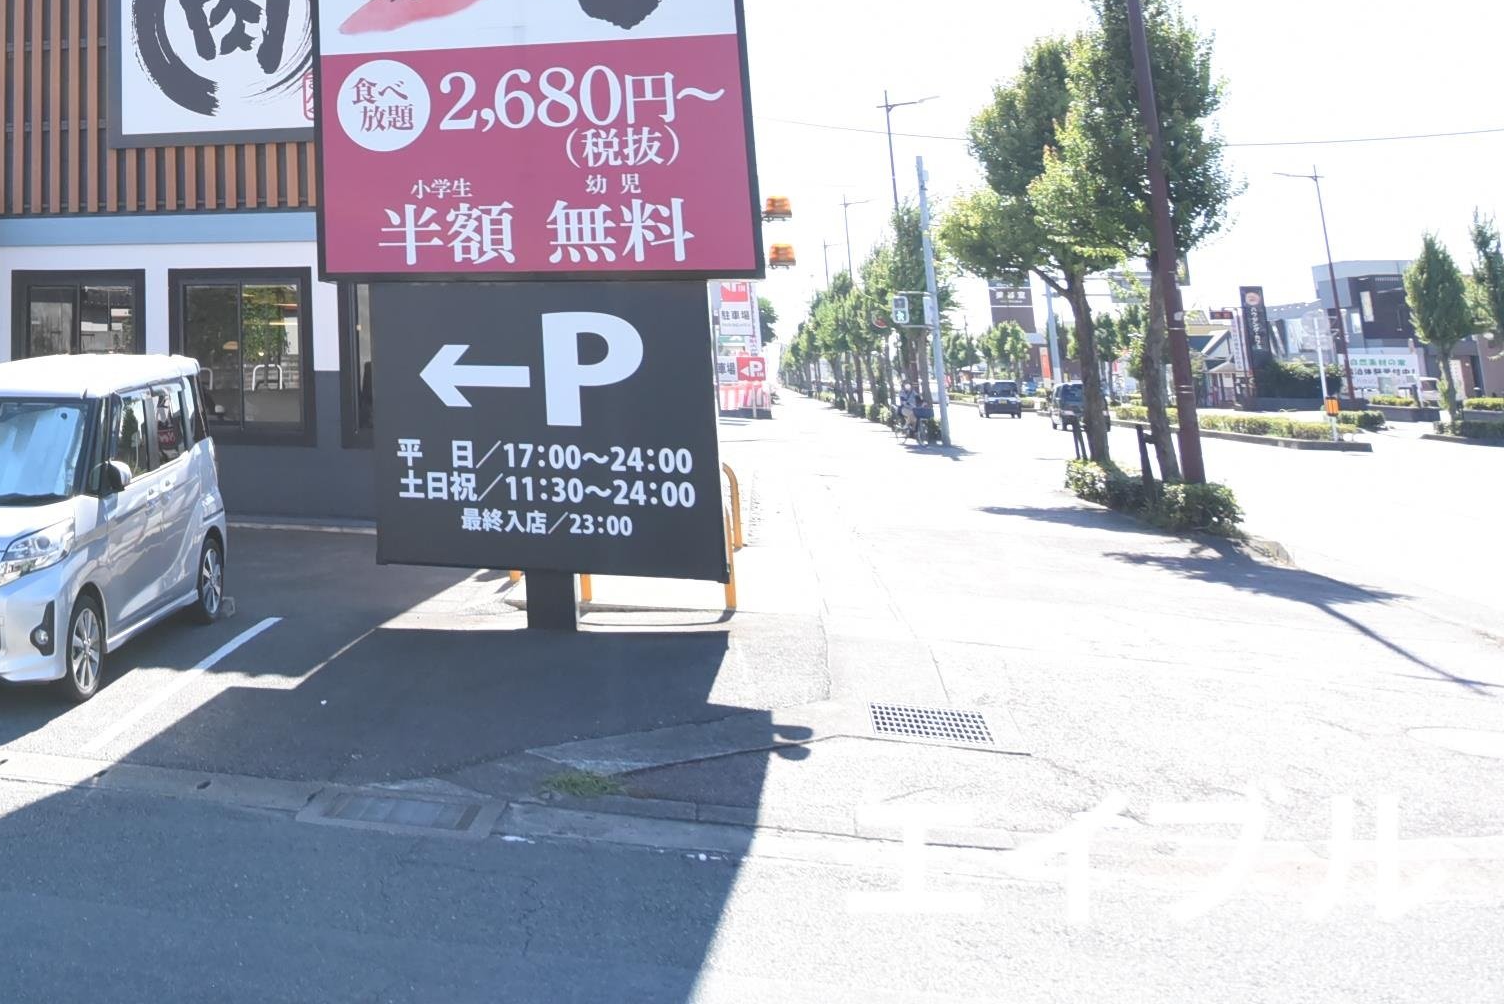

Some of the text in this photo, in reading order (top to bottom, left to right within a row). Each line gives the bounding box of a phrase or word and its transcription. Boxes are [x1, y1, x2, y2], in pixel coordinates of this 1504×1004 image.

[351, 77, 410, 106] 食べ
[360, 103, 415, 133] 放題
[410, 177, 473, 199] 小学生
[378, 197, 695, 266] 半額 無料
[541, 310, 644, 427] P
